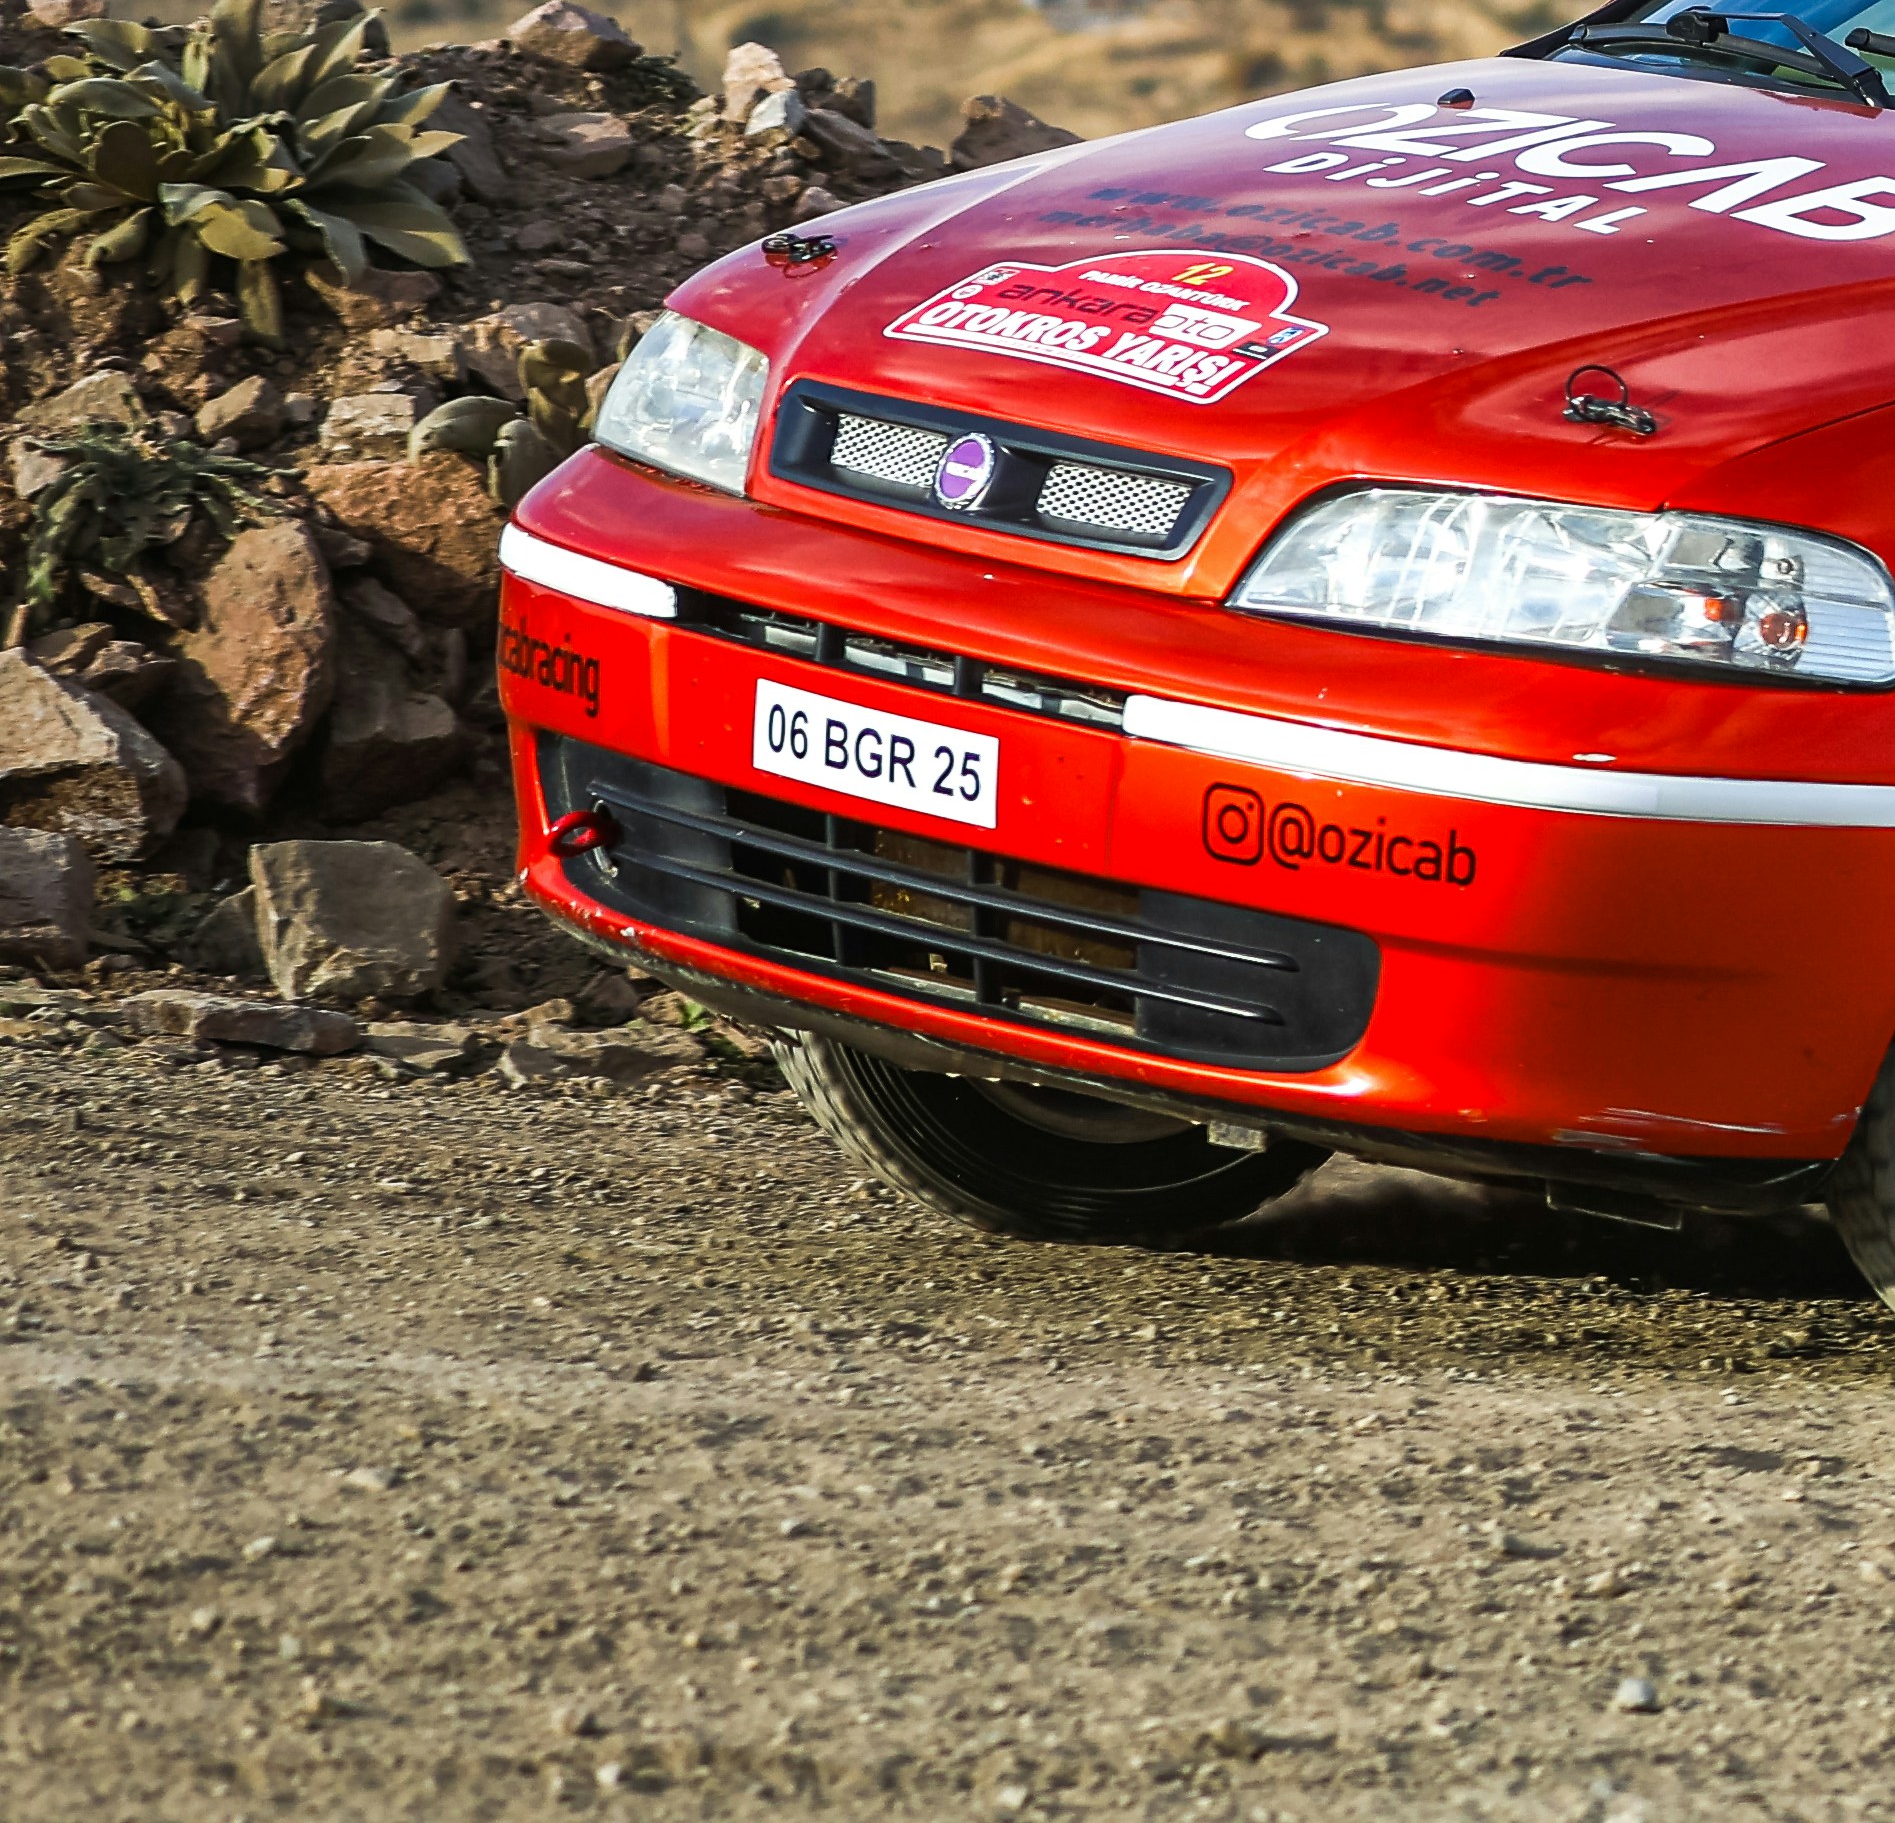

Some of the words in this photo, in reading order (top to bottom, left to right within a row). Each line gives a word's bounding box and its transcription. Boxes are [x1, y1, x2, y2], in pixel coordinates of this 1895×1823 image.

[1038, 210, 1501, 308] merhaba@ozicab.net
[1086, 186, 1594, 289] www.ozicab.com.tr
[1171, 262, 1236, 286] 12
[918, 300, 1111, 353] OTOKROS
[767, 702, 809, 761] 06
[824, 718, 917, 789] BGR
[933, 744, 982, 803] 25
[1267, 801, 1477, 887] @ozicab
